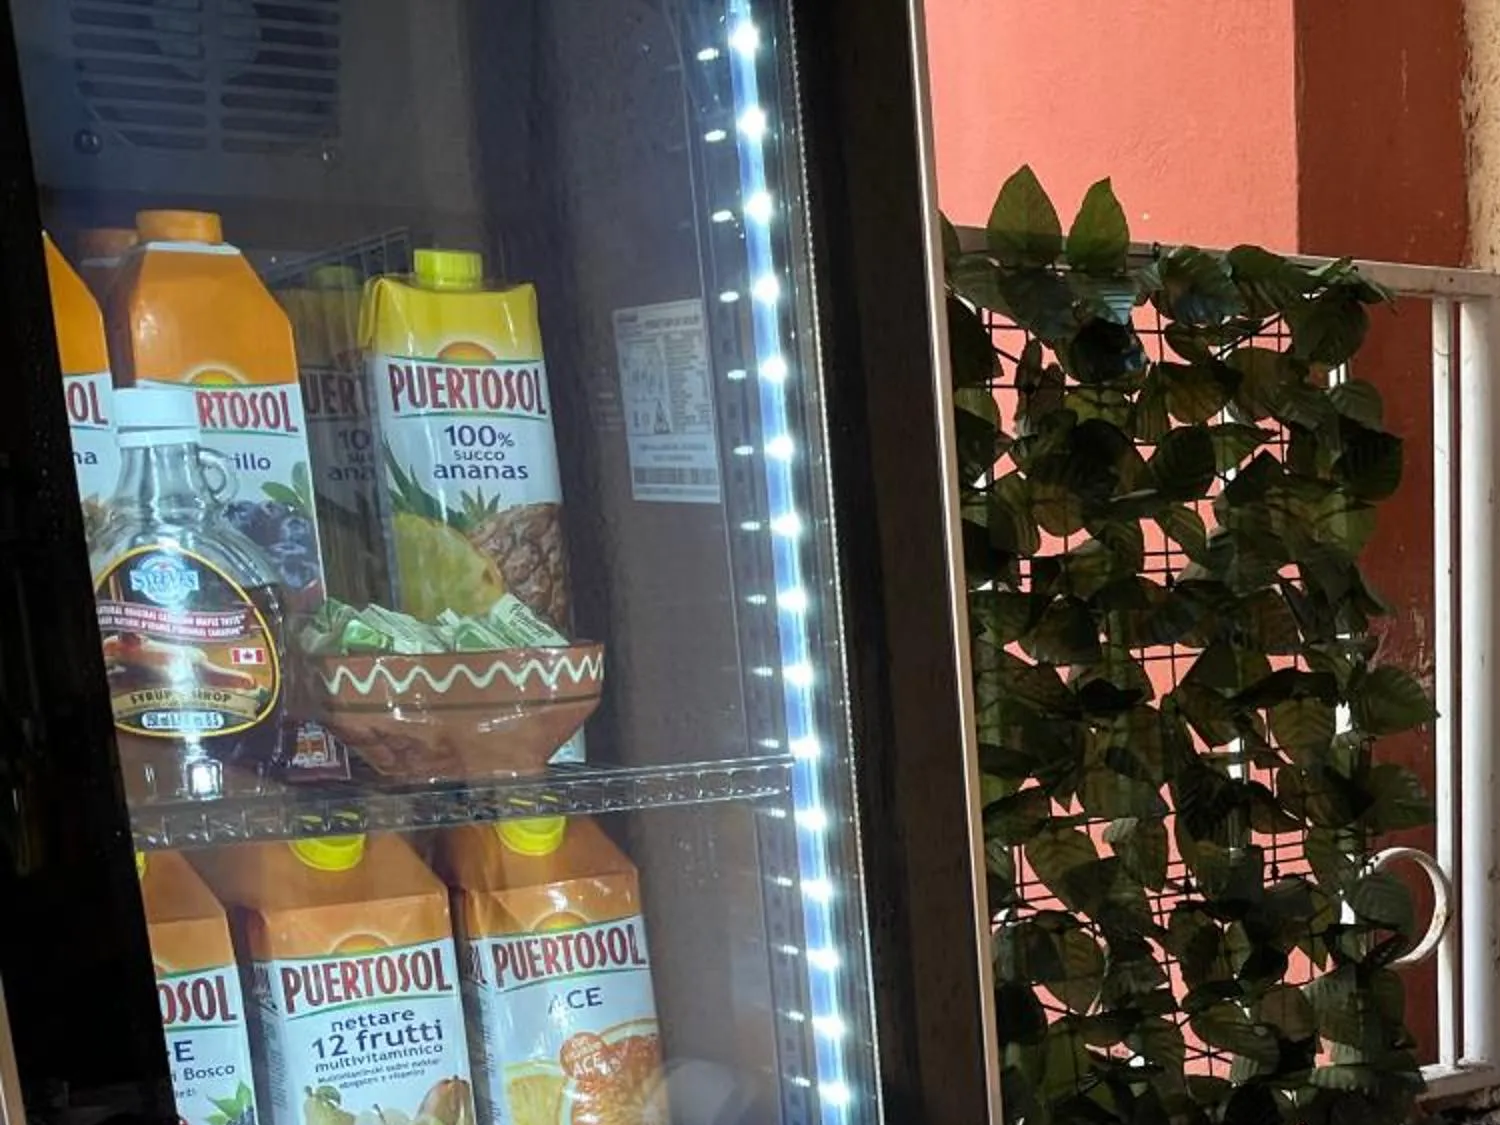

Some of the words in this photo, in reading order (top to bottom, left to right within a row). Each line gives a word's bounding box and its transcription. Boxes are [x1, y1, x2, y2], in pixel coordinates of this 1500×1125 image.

[387, 363, 547, 416] PUERTOSOL
[193, 389, 299, 433] RTOSOL
[444, 424, 515, 448] 100%
[231, 453, 272, 472] illo
[454, 449, 505, 462] succo
[433, 463, 529, 480] ananas
[492, 923, 647, 988] PUERTOSOL
[280, 947, 453, 1014] PUERTOSOL
[331, 1008, 415, 1032] nettare
[311, 1034, 348, 1059] 12
[355, 1019, 444, 1052] frutti
[314, 1044, 443, 1073] multivitaminico
[183, 1064, 235, 1081] Bosco
